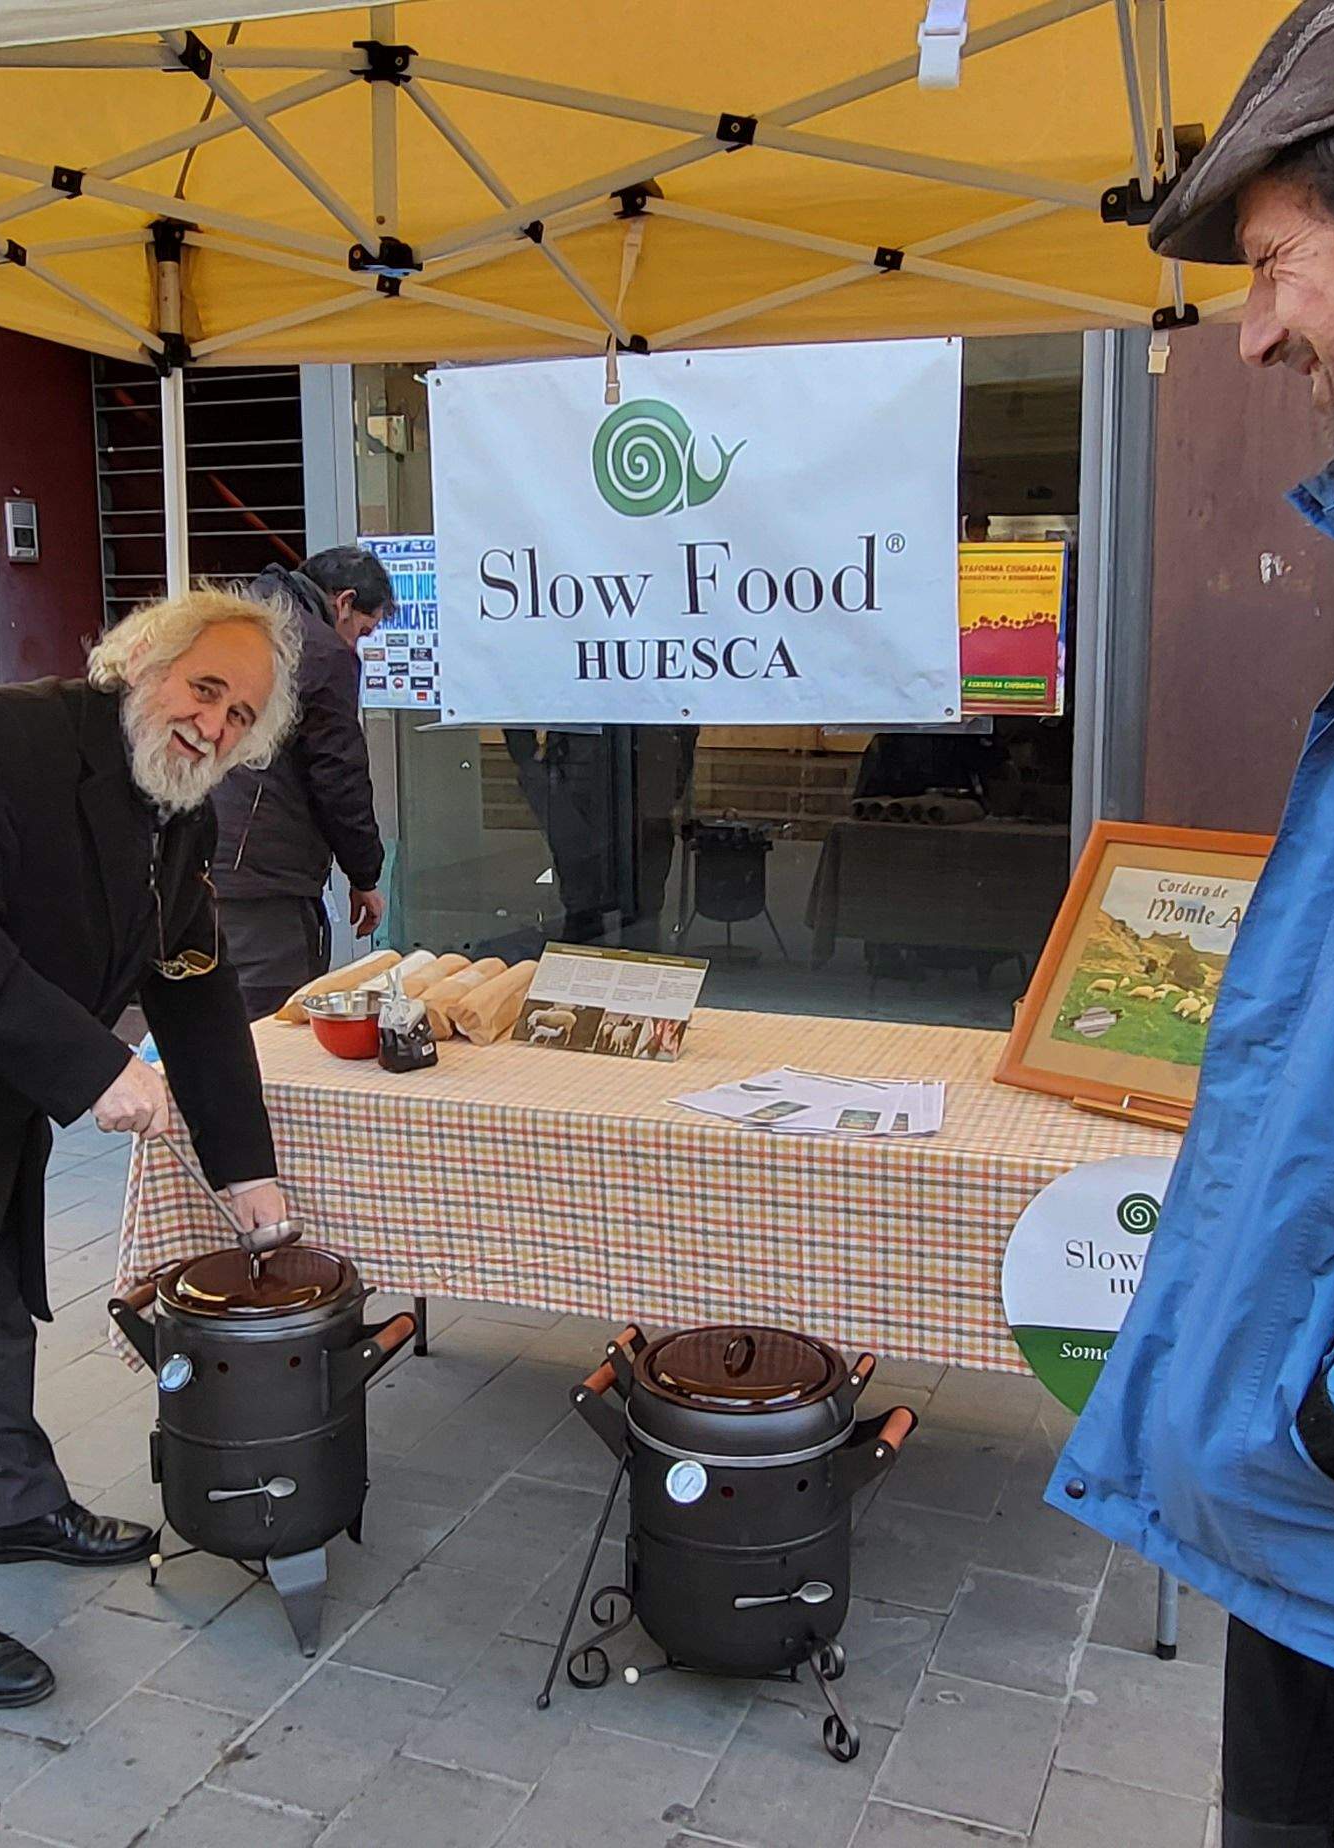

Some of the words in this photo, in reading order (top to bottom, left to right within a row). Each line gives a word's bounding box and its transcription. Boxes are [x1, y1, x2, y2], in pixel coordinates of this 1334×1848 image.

[479, 545, 653, 621] Slow
[575, 636, 800, 681] HUESCA
[1157, 878, 1210, 898] Cordero
[1213, 882, 1228, 898] de
[1147, 897, 1216, 927] Monte
[1066, 1239, 1144, 1271] Slow
